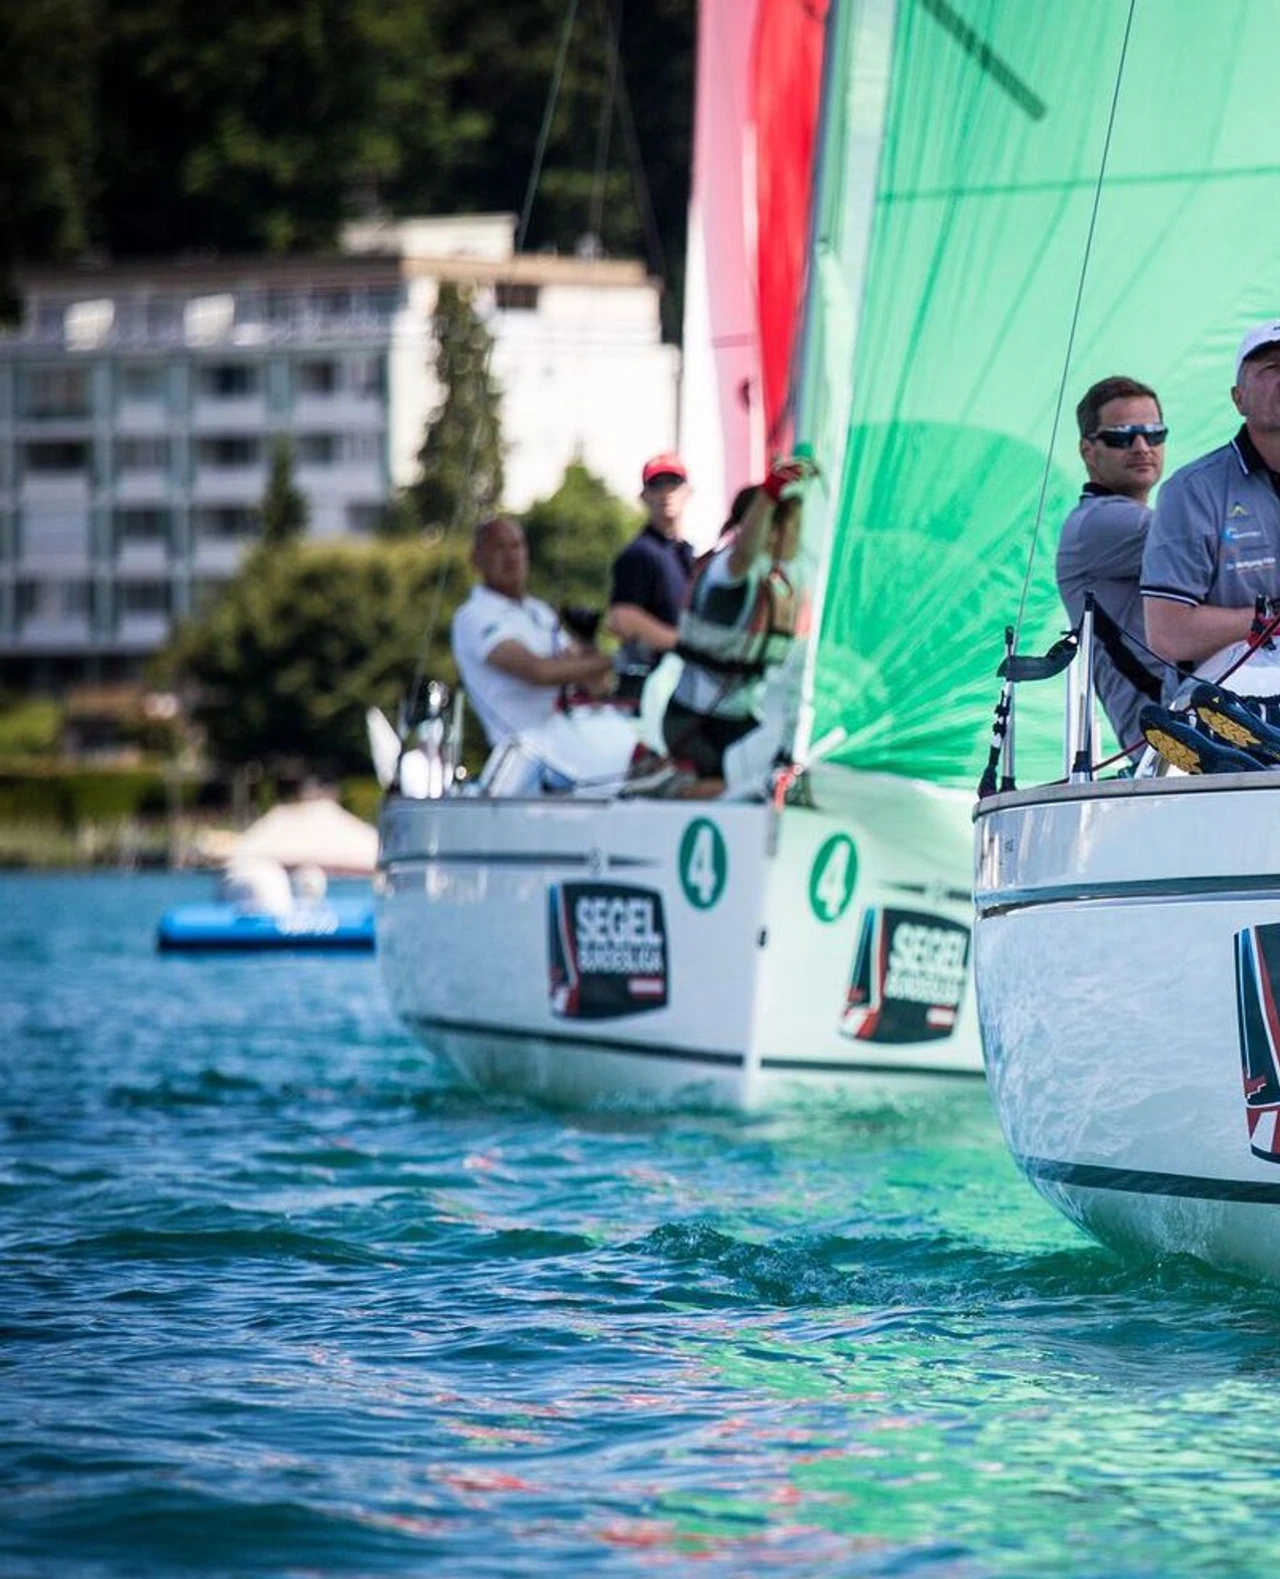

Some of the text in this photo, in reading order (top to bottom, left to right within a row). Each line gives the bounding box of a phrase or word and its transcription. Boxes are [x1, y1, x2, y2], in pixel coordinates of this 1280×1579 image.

[687, 824, 717, 904] 4
[816, 839, 851, 918] 4
[576, 896, 664, 944] SEGEL
